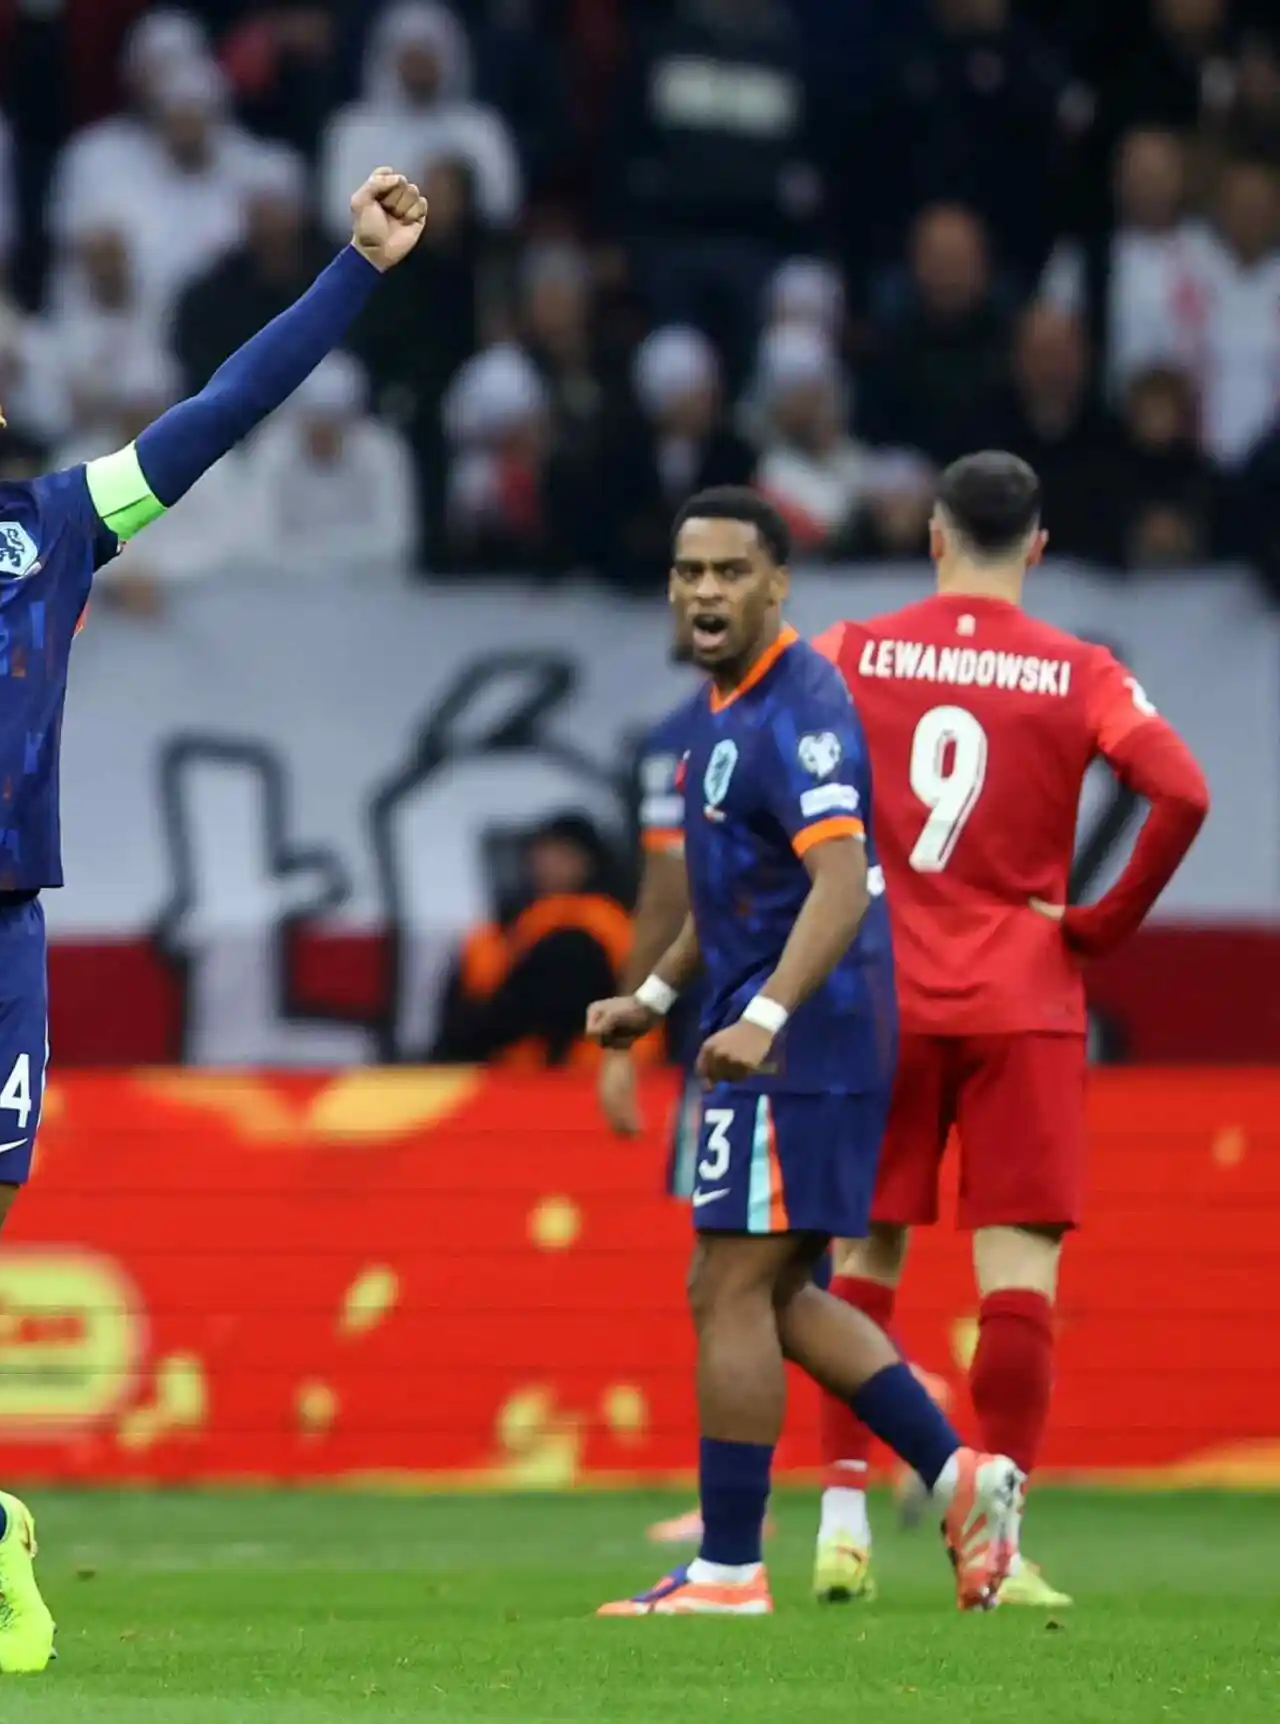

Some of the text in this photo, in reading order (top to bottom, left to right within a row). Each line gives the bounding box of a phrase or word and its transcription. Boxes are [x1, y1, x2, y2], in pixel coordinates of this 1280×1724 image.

[859, 639, 1071, 697] LEWANDOWSKI
[908, 705, 989, 873] 9
[698, 1108, 735, 1181] 3
